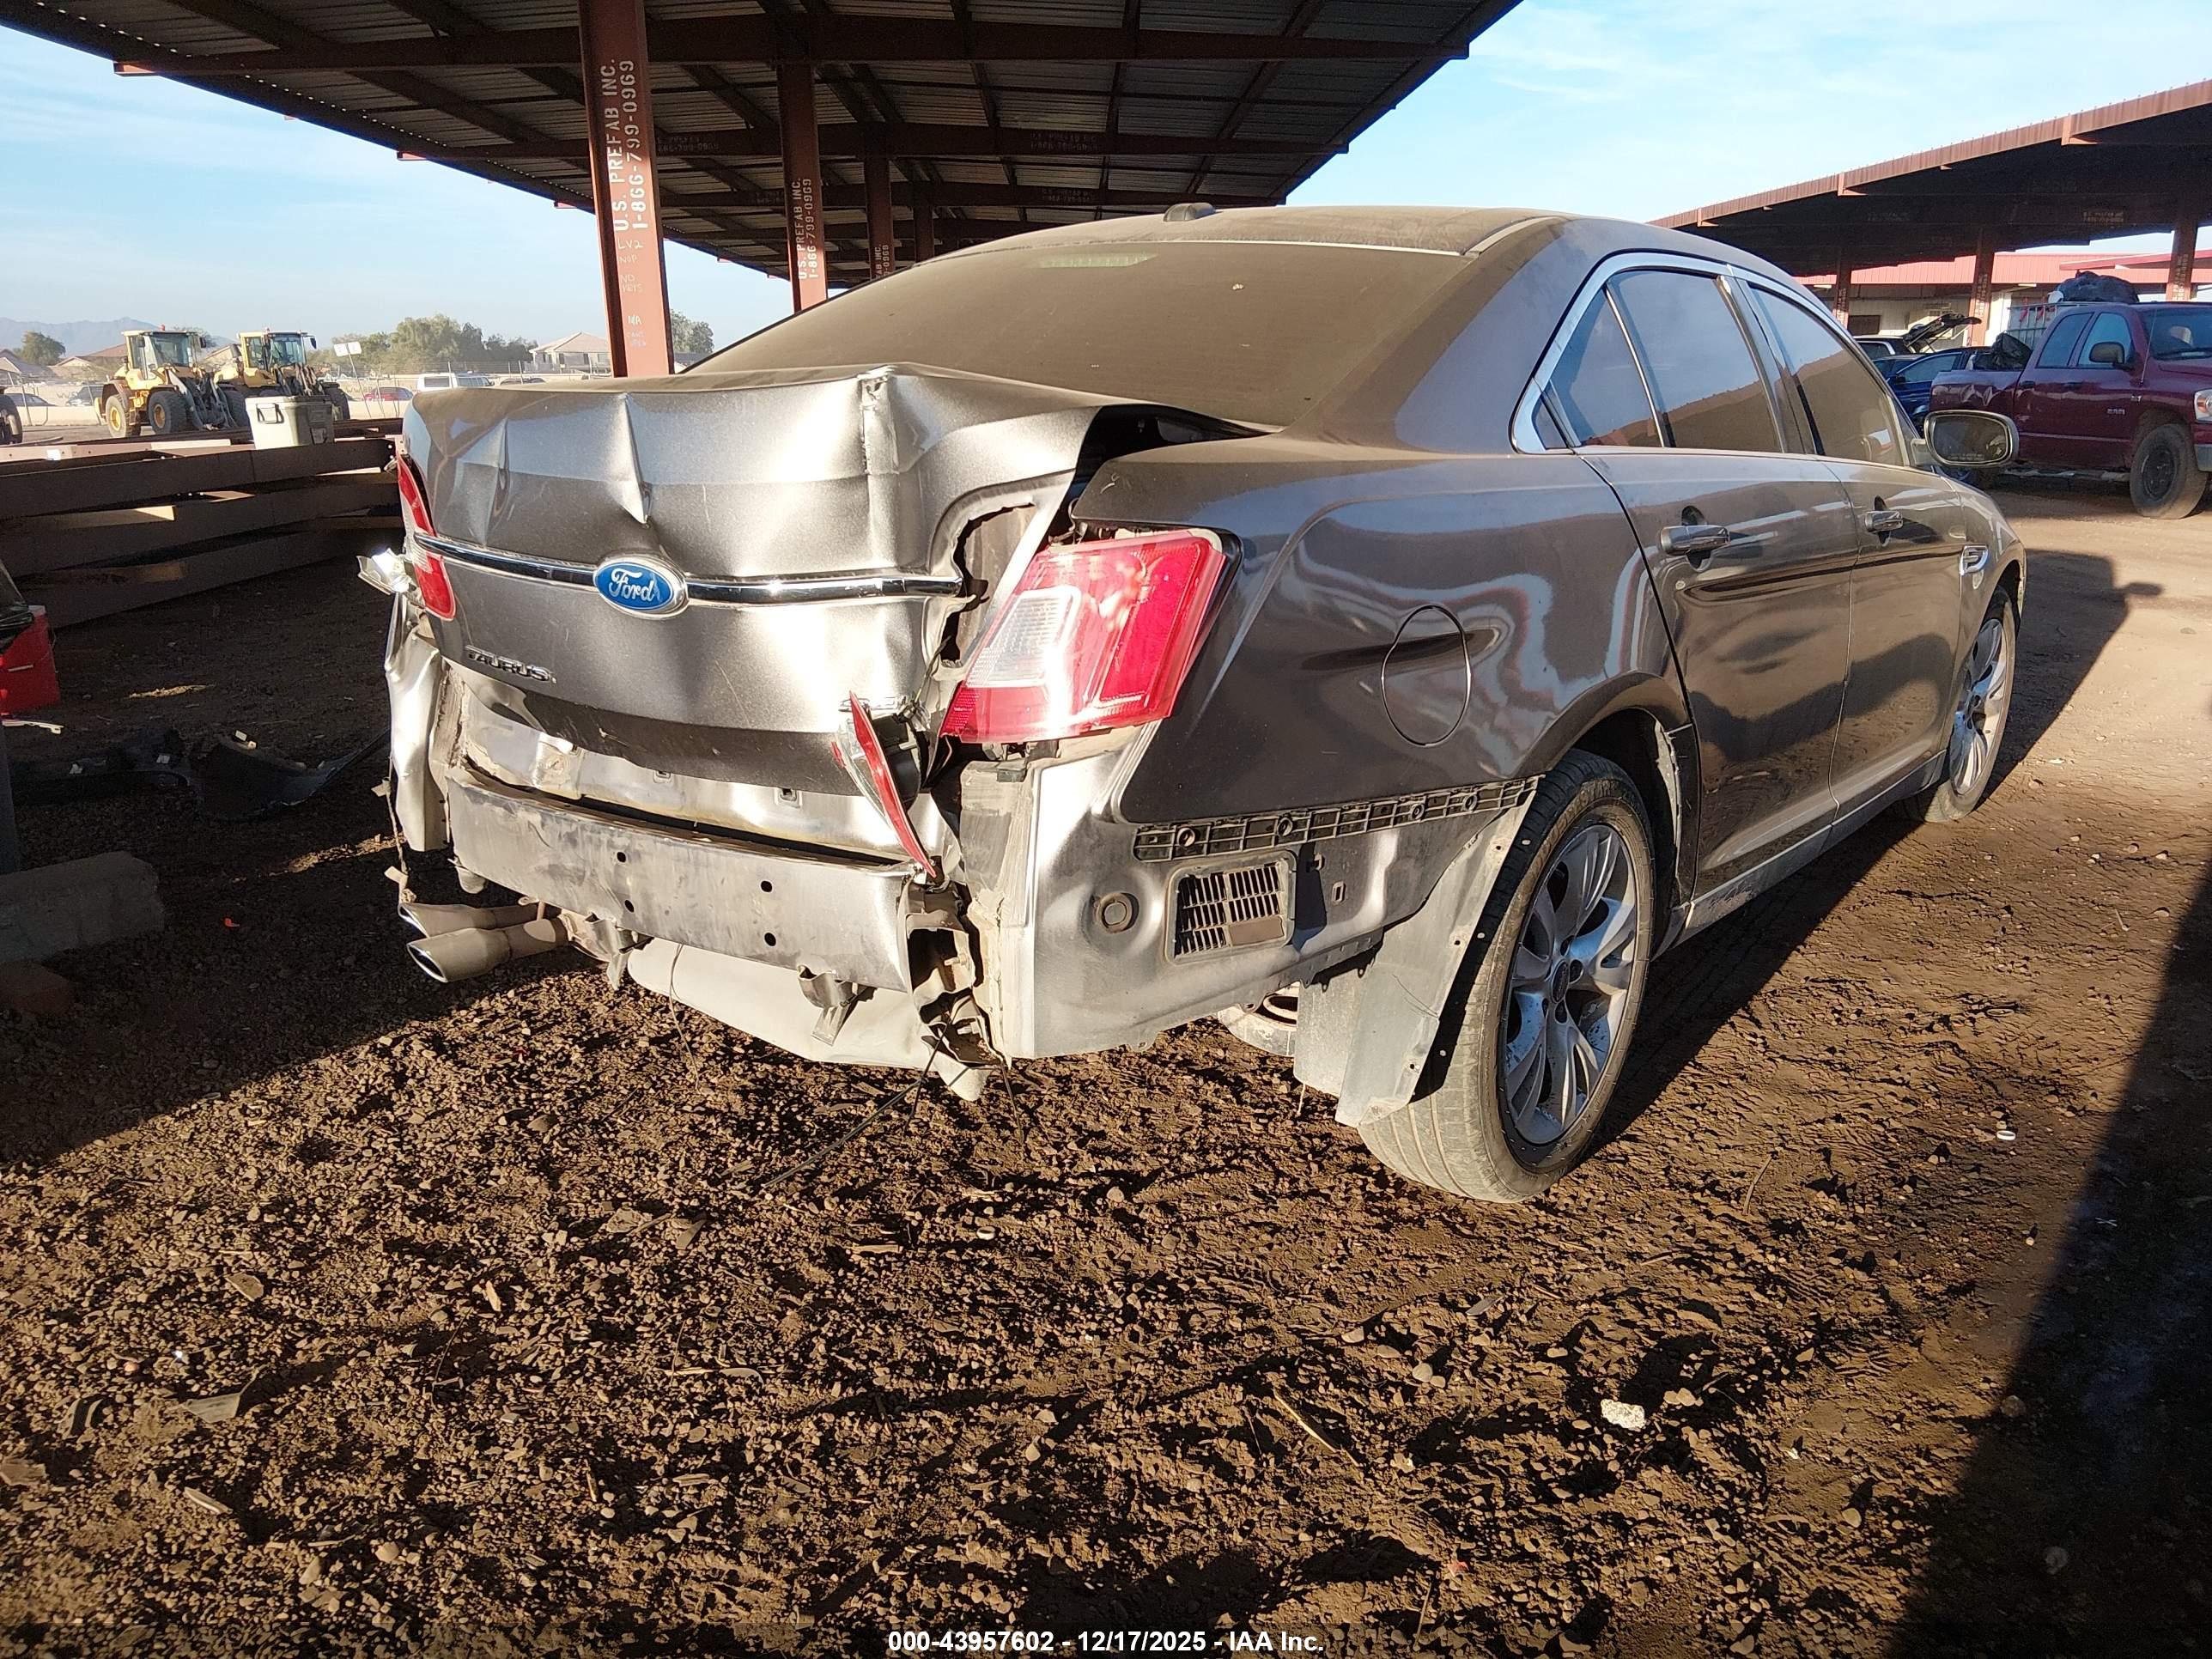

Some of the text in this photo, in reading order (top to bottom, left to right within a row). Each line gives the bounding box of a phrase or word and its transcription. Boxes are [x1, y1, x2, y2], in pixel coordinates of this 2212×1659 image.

[600, 58, 629, 232] U.S. PREFAB INC.
[619, 60, 648, 228] 1-866-799-0969
[792, 178, 808, 280] U.S. PREFAB INC.
[802, 179, 818, 278] 1-866-799-0969
[608, 568, 659, 603] Ford
[465, 644, 550, 681] TAURUS
